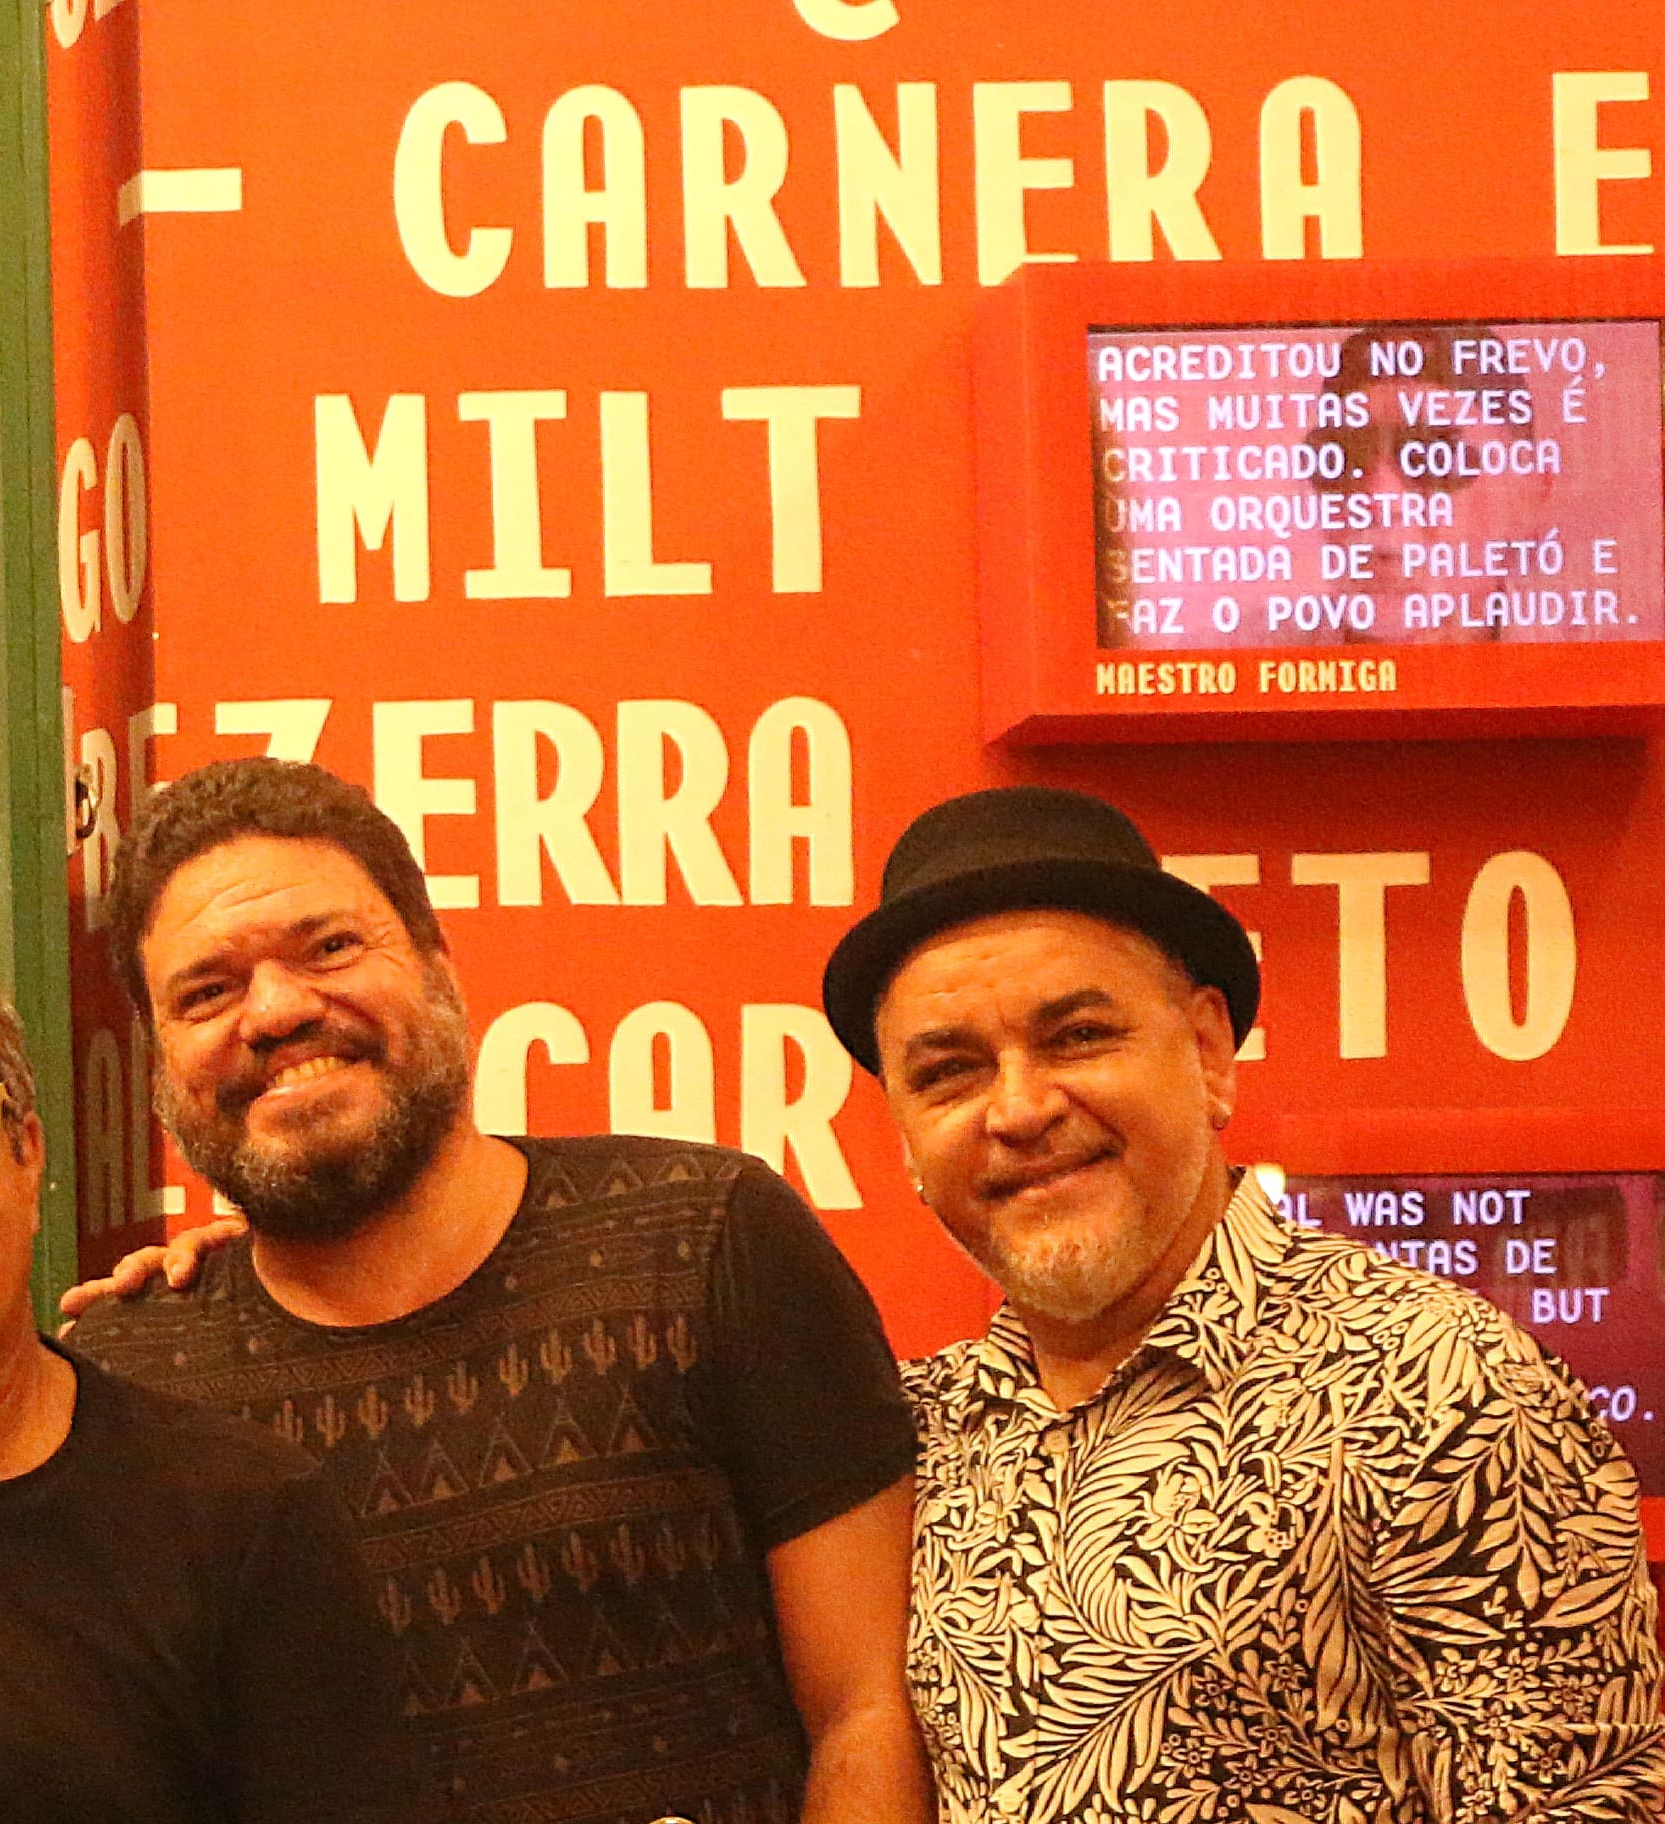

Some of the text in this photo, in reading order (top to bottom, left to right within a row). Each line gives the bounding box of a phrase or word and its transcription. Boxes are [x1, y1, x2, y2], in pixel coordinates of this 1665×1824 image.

[393, 78, 1363, 297] CARNERA
[1098, 337, 1607, 382] ACREDITOU NO FREVO,
[1099, 375, 1587, 432] MAS MUITAS VEZES É
[1104, 437, 1561, 482] CRITICADO. COLOCA
[314, 385, 861, 604] MILT
[1210, 491, 1454, 540] ORQUESTRA
[1319, 543, 1375, 581] DE
[1401, 527, 1564, 578] PALETÓ
[1592, 538, 1619, 575] E
[1211, 595, 1241, 633] O
[1265, 593, 1376, 632] POVO
[1403, 589, 1639, 629] APLAUDIR.
[1095, 659, 1397, 695] MAESTRO FORMIGA
[1343, 1190, 1425, 1227] WAS
[1452, 1189, 1532, 1226] NOT
[1505, 1238, 1558, 1276] DE
[1530, 1287, 1611, 1324] BUT
